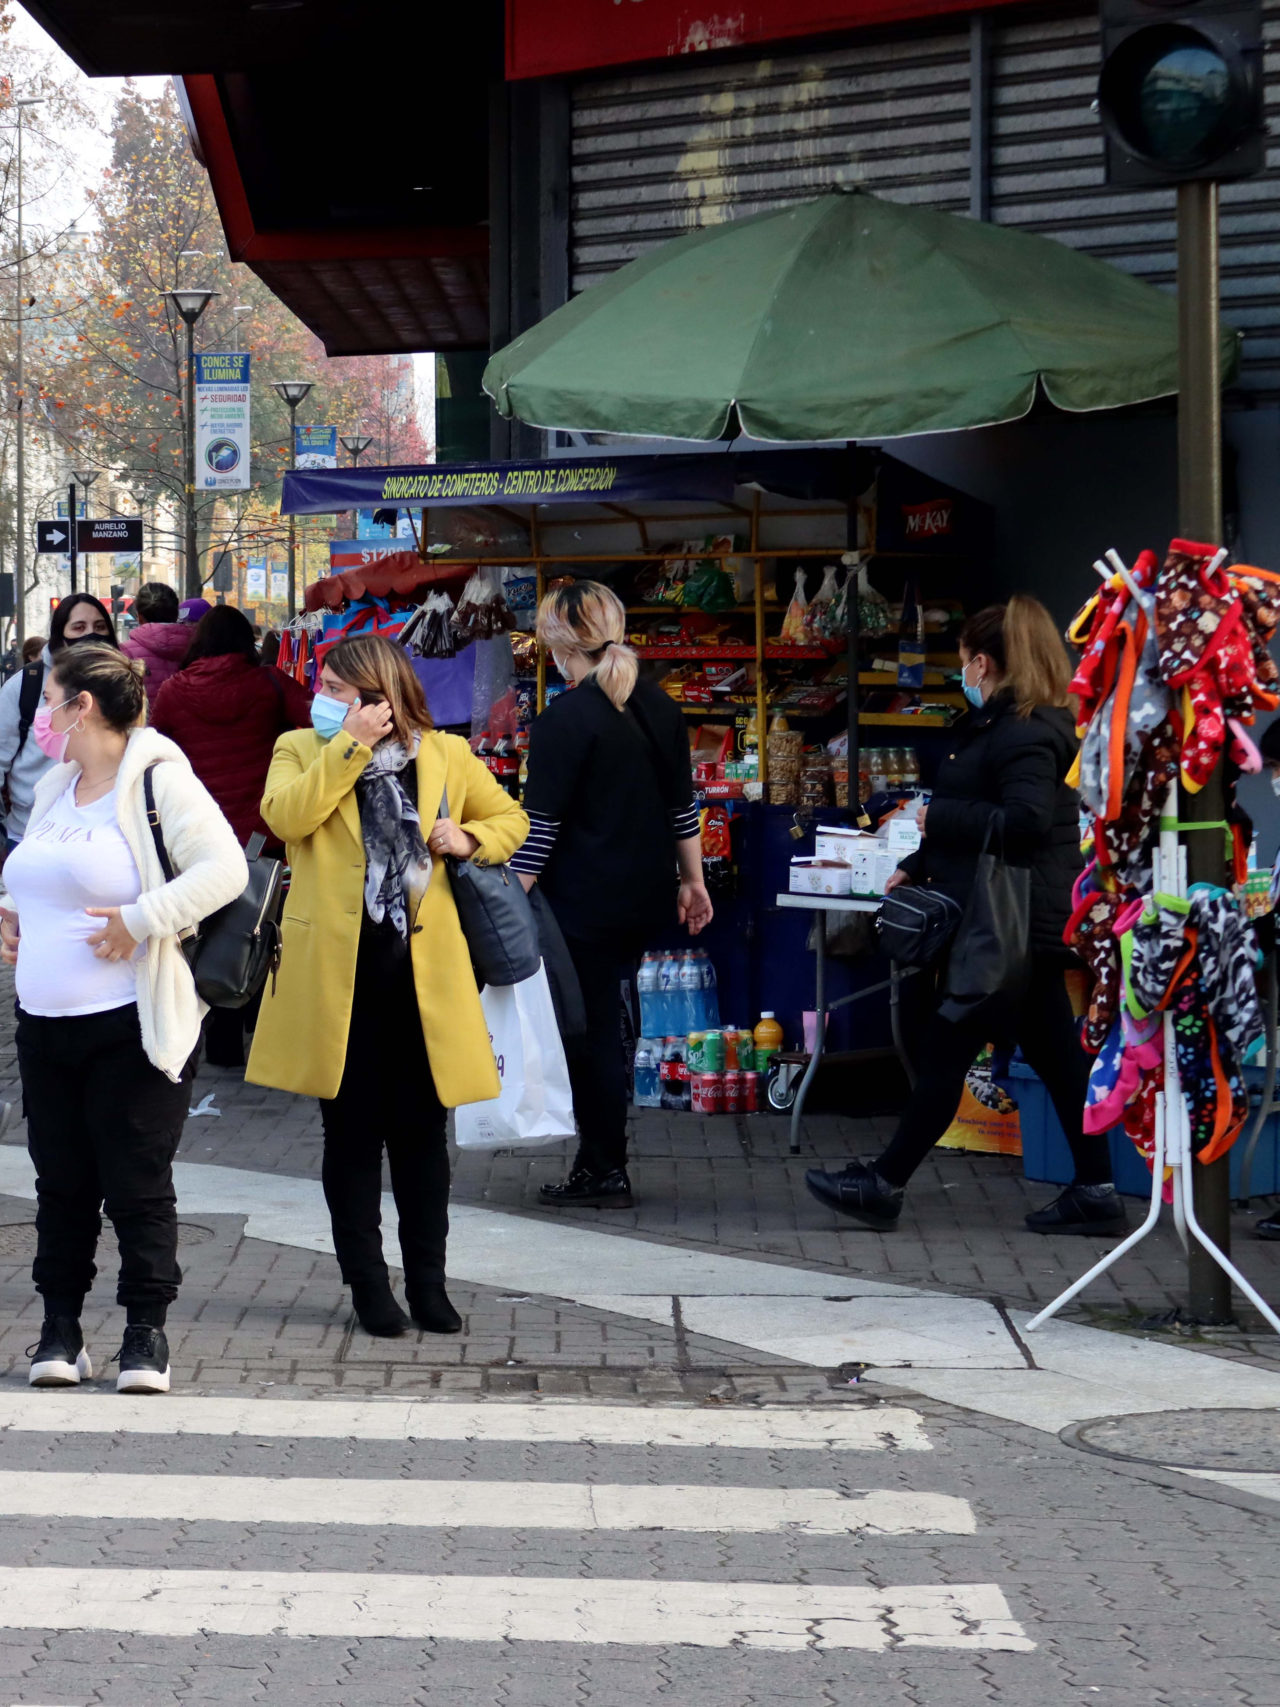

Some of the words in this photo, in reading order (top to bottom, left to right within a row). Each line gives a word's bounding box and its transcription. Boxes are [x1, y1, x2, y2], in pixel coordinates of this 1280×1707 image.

[201, 356, 231, 368] CONCE
[233, 356, 244, 368] SE
[204, 368, 242, 380] ILUMINA
[210, 394, 247, 403] SEGURIDAD
[382, 475, 429, 499] SINDICATO
[428, 475, 444, 497] DE
[441, 472, 500, 497] CONFITEROS
[504, 469, 542, 495] CENTRO
[540, 469, 556, 493] DE
[555, 463, 617, 492] CONCEPCIÓN
[94, 523, 127, 531] AURELIO
[92, 531, 129, 539] MANZANO
[361, 547, 405, 564] $12
[705, 785, 729, 795] TURRÓN
